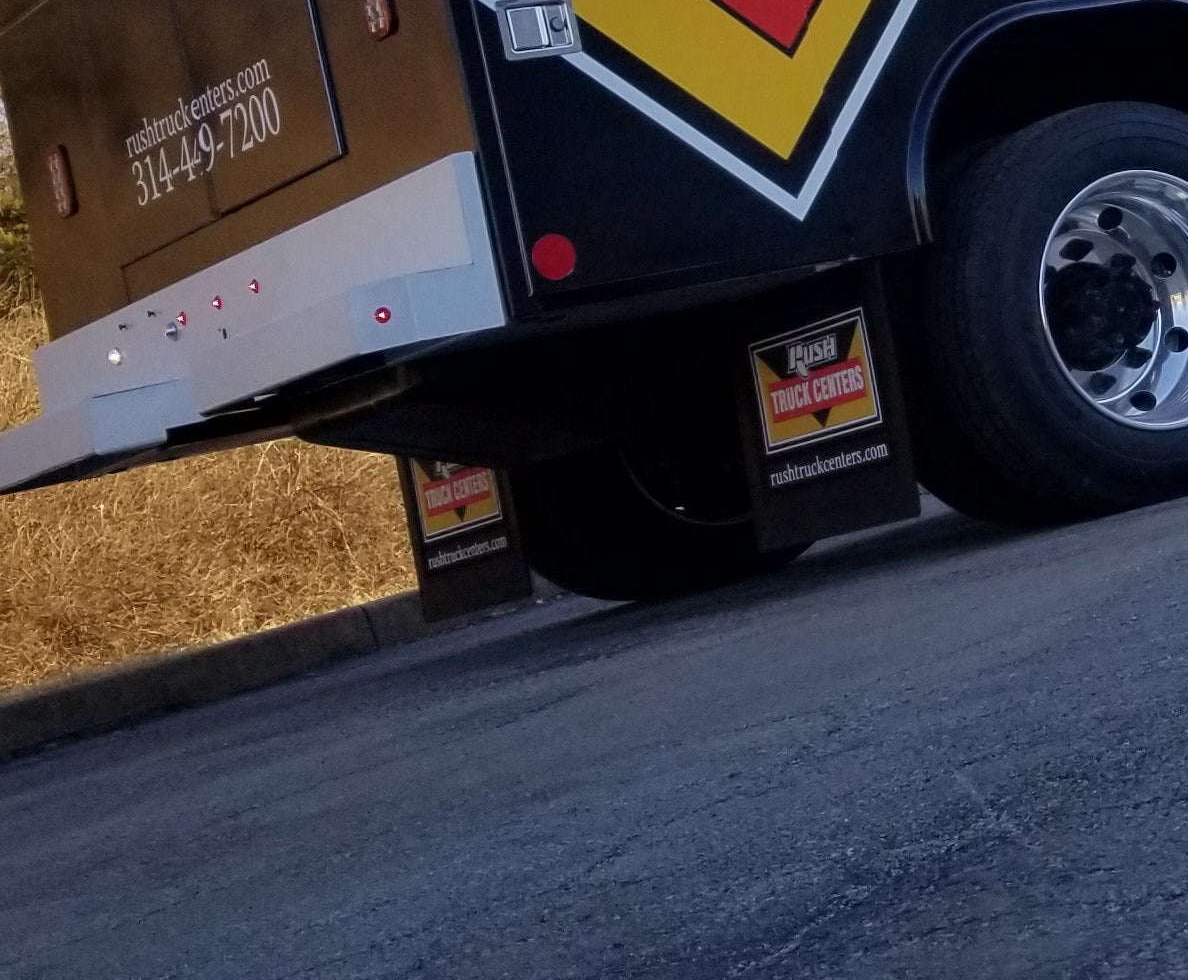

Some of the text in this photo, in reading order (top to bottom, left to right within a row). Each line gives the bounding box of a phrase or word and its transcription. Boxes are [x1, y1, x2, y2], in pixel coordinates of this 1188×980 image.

[126, 58, 271, 158] rushtruckenters.com
[131, 87, 280, 206] 314-449-7200
[770, 365, 865, 414] TRUCK CENTERS
[770, 443, 889, 487] rushtruckcenters.com
